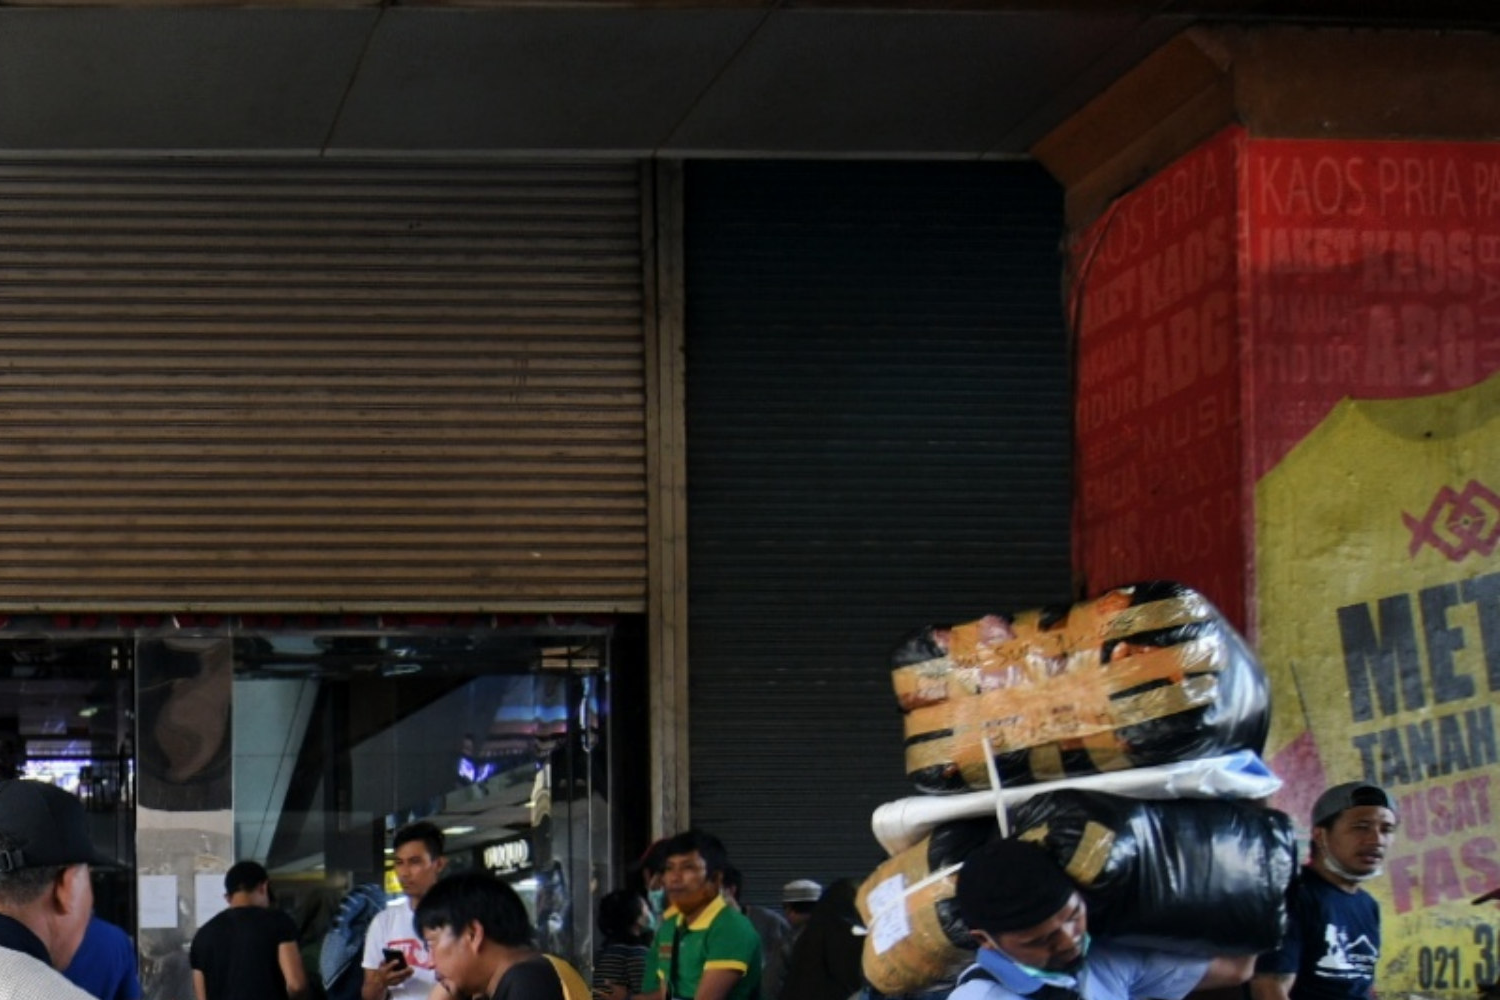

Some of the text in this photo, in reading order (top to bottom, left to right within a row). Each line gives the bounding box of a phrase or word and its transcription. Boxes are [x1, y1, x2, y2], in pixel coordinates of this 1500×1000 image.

[1153, 150, 1221, 241] PRIA
[1258, 156, 1367, 216] KAOS
[1378, 156, 1467, 217] PRIA
[1138, 216, 1228, 320] KAOS
[1360, 229, 1475, 293] KAOS
[1141, 290, 1230, 409] ABG
[1363, 304, 1476, 387] ABG
[1352, 704, 1498, 790] TANAH
[1396, 775, 1493, 843] USAT
[1417, 922, 1500, 990] 021.3
